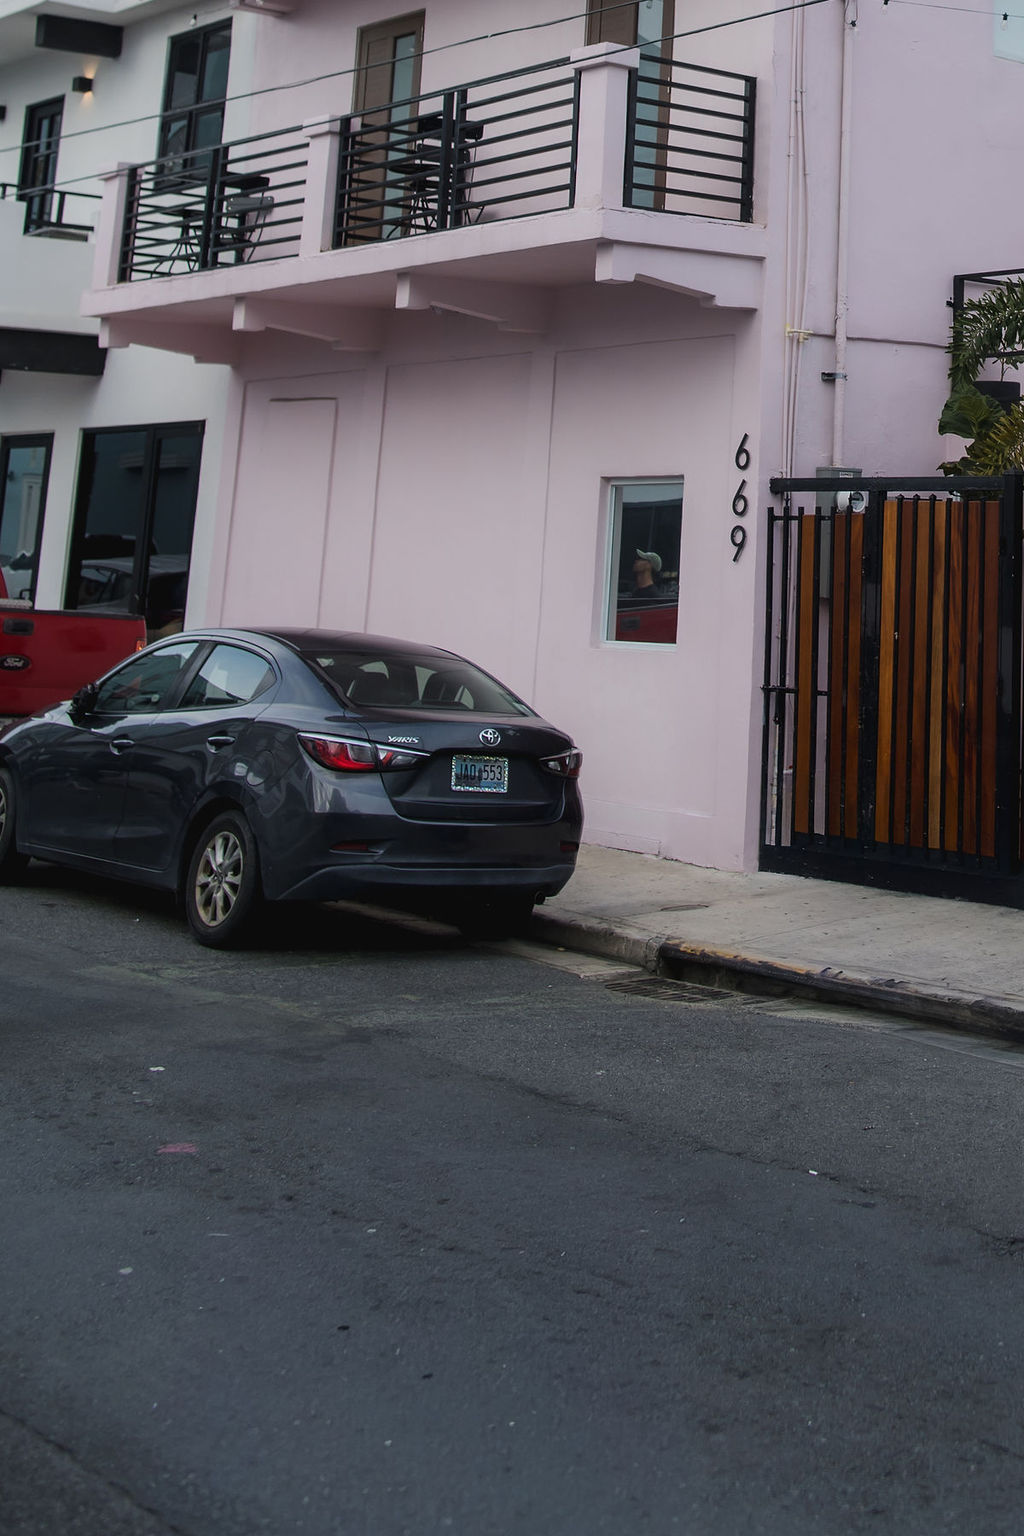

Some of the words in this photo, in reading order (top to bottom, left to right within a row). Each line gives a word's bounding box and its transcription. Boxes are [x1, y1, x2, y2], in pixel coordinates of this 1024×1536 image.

[730, 432, 750, 562] 669
[388, 735, 420, 743] YARIS
[483, 764, 503, 781] 553
